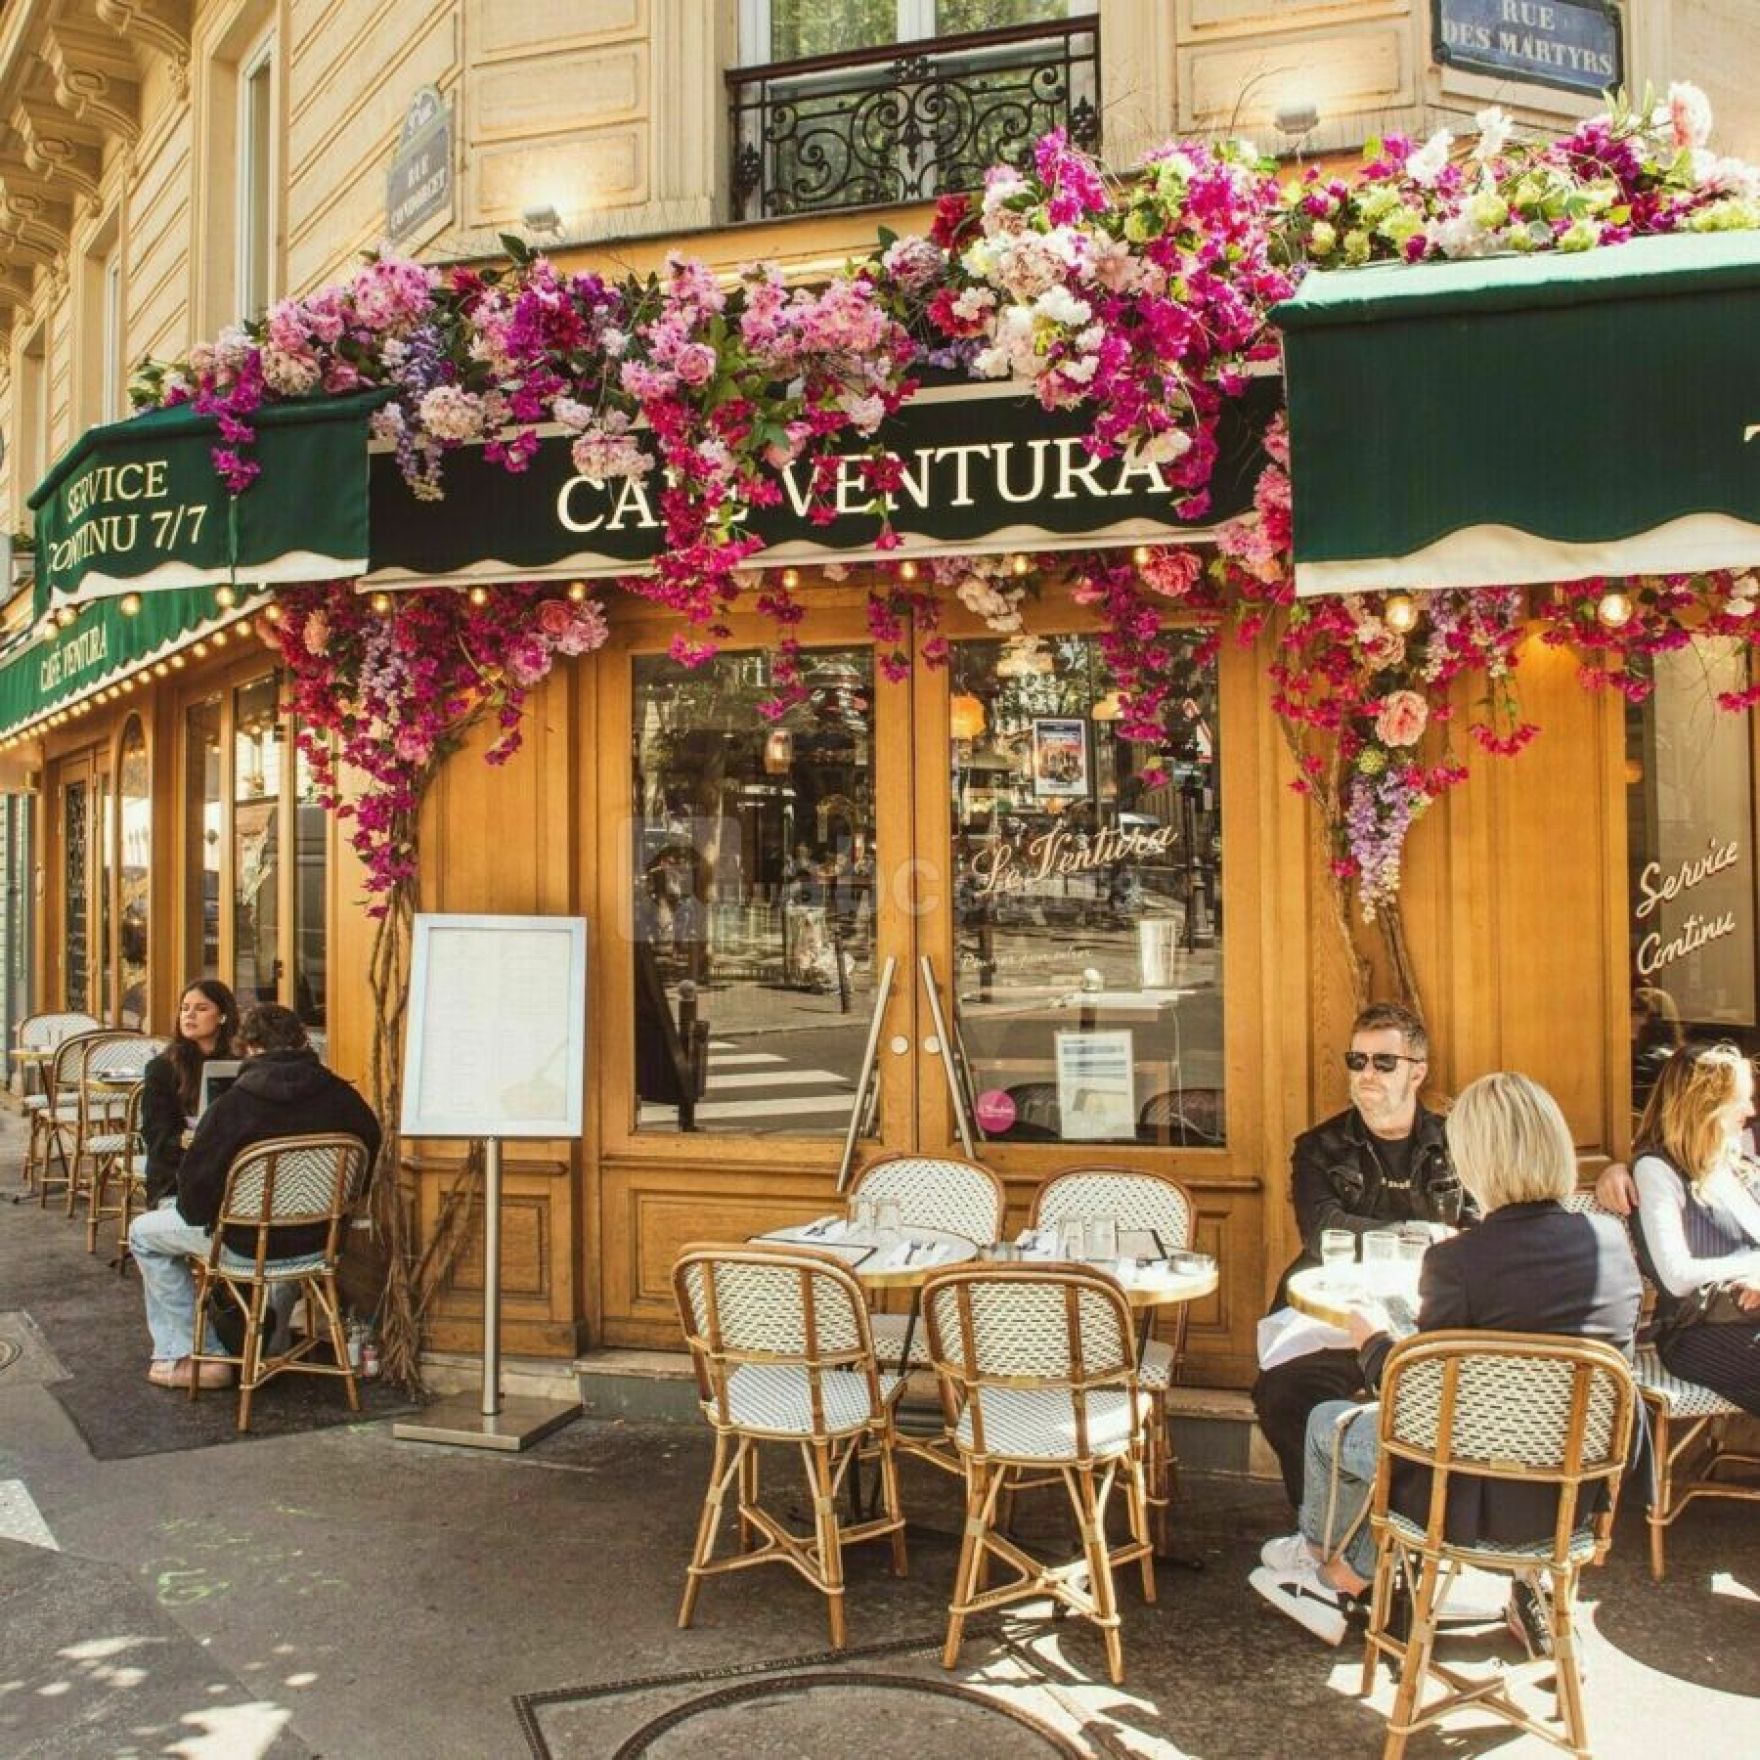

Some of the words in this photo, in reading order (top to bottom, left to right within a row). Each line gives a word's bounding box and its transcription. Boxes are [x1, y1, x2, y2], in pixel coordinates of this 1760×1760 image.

[1441, 17, 1491, 49] DES
[1500, 31, 1612, 75] MARTYRS
[1502, 0, 1555, 31] RUE
[67, 460, 169, 524] SERVICE
[556, 470, 749, 533] CA
[782, 437, 1174, 518] VENTURA
[151, 503, 208, 551] 7/7
[1030, 817, 1178, 883] Ventura
[1636, 835, 1739, 918] Service
[1637, 911, 1735, 975] Continu
